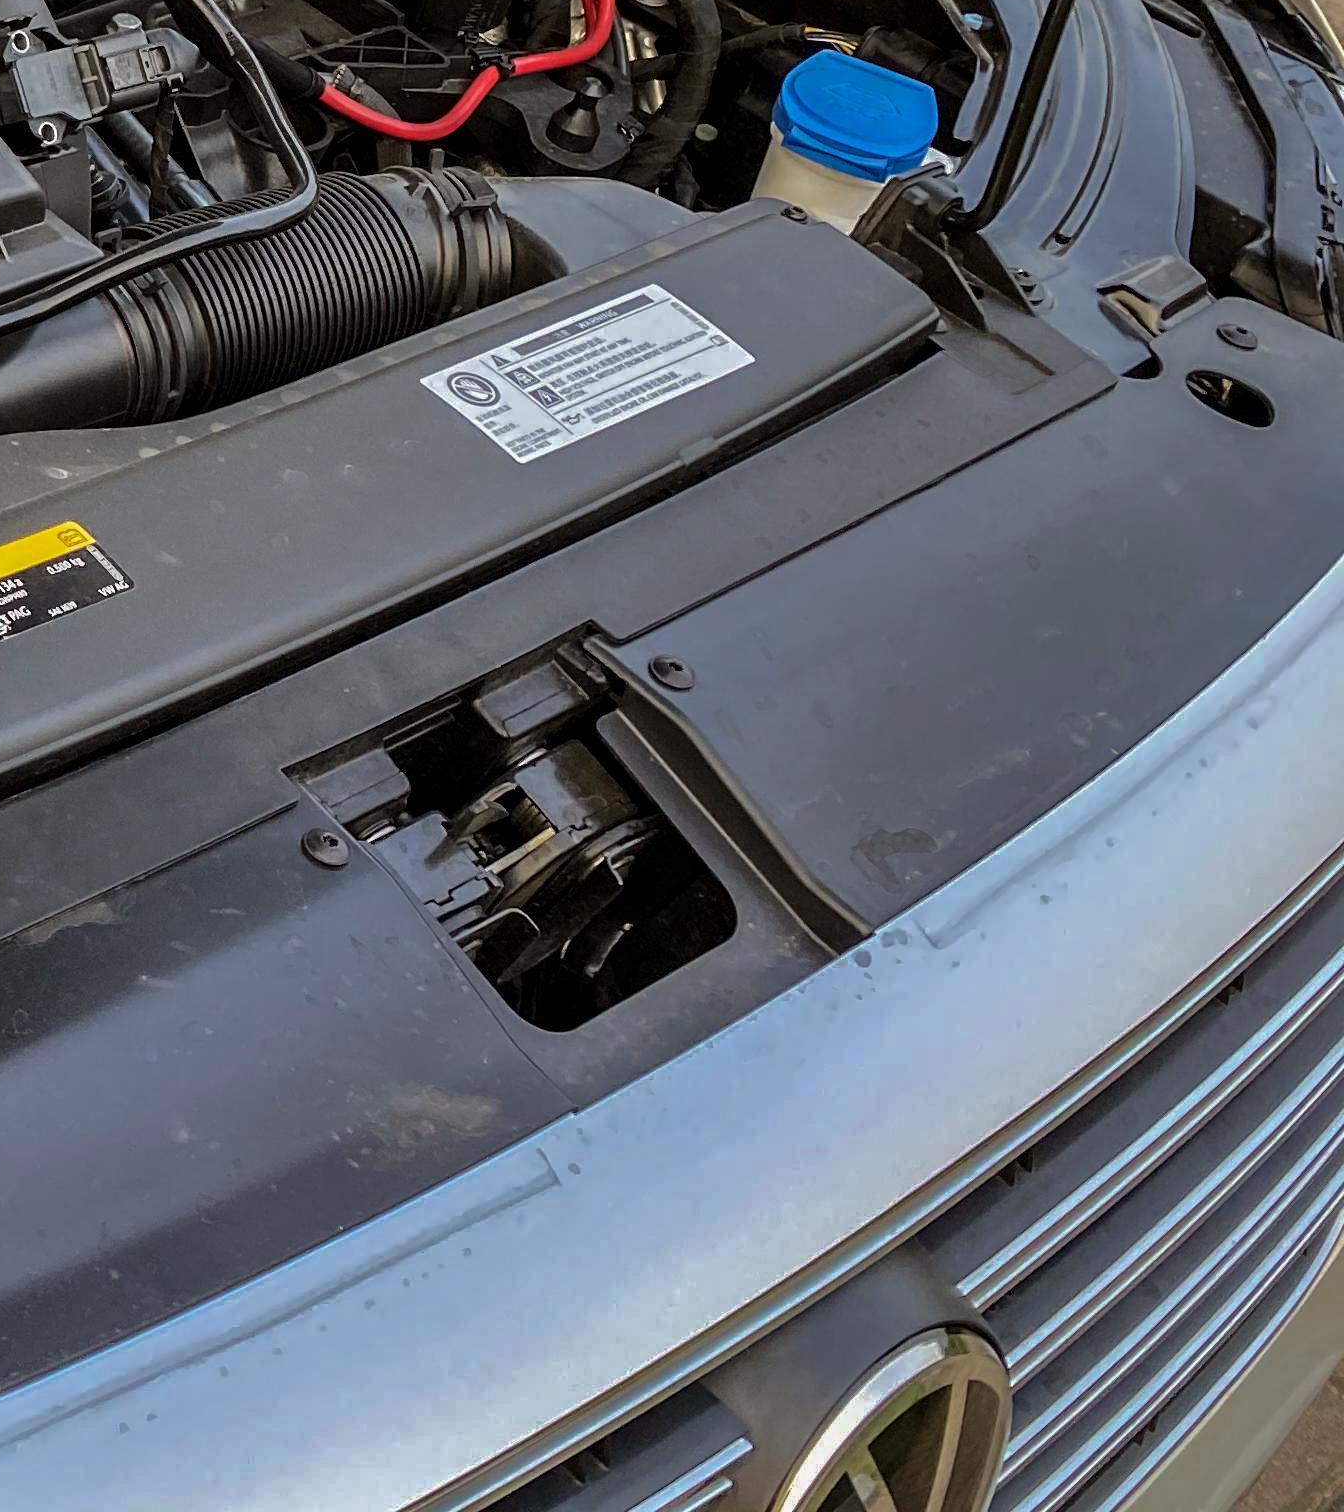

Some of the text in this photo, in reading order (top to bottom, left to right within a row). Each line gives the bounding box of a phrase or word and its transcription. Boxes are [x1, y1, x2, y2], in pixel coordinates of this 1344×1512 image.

[575, 310, 619, 330] WARNING
[97, 580, 130, 597] VW AG
[7, 605, 32, 622] PAG
